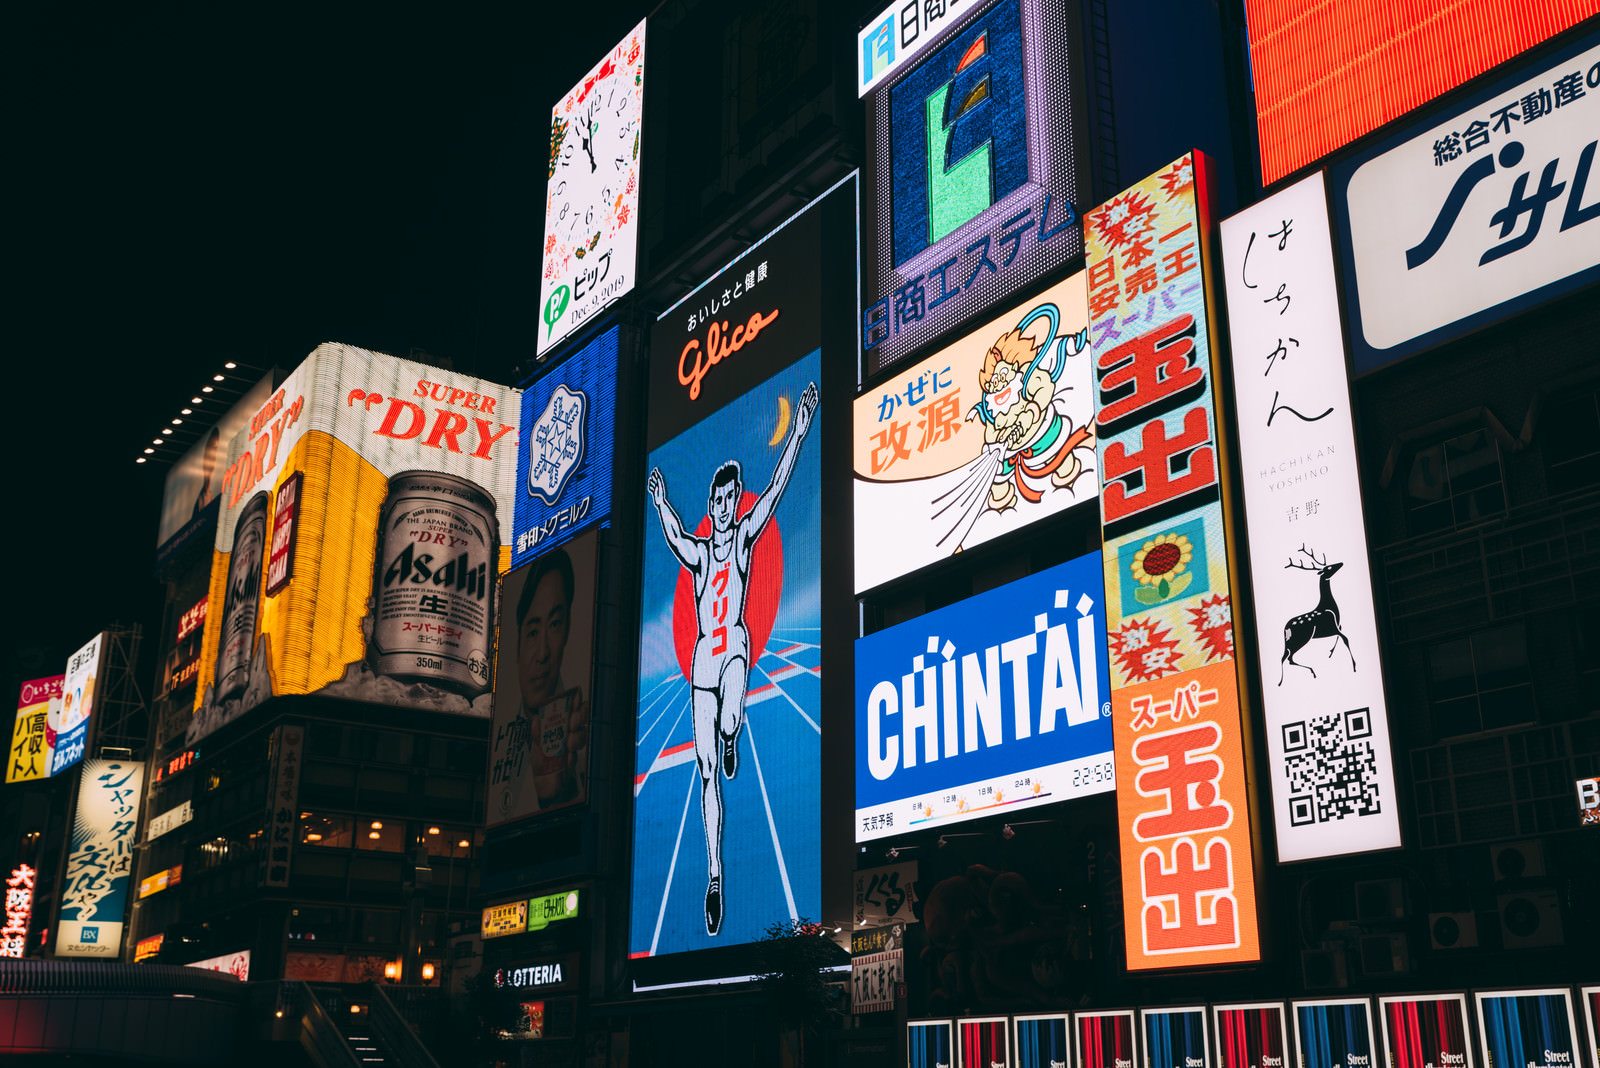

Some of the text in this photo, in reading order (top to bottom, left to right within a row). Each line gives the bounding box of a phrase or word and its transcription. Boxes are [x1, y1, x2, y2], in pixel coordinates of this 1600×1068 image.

[901, 0, 959, 49] 日商
[574, 248, 613, 301] ピップ
[863, 194, 1076, 350] 日商エステム
[1087, 222, 1193, 292] 日本一
[1089, 242, 1198, 321] 安売王
[687, 261, 768, 332] おいしさと健康
[1092, 283, 1201, 349] スーパー
[678, 309, 779, 400] Glico
[248, 388, 285, 441] SUPER
[413, 379, 497, 415] SUPER
[877, 366, 953, 423] かぜに
[1096, 313, 1215, 524] 玉出
[869, 387, 962, 476] 改源
[1260, 445, 1335, 479] HACHIKAN
[1269, 465, 1329, 492] YOSHINO
[422, 518, 447, 527] JAPAN
[449, 519, 473, 536] BRAND
[516, 496, 591, 555] 雪印メグミルク
[384, 542, 486, 600] Asahi
[419, 595, 449, 616] 生
[711, 561, 731, 657] グリコ
[402, 622, 463, 640] スーパードライ
[416, 657, 442, 670] 350ml
[867, 589, 1100, 781] CHINTAI
[1130, 680, 1219, 732] スーパー
[1073, 762, 1113, 787] 22:58
[862, 812, 894, 833] 天気予報
[1132, 719, 1241, 957] 玉出
[82, 929, 97, 940] BX
[507, 963, 562, 988] LOTTERIA
[1115, 1058, 1131, 1068] Street
[1185, 1056, 1203, 1068] Street
[1262, 1054, 1282, 1066] Street
[1347, 1053, 1368, 1065] Street
[1440, 1051, 1463, 1064] Street
[1544, 1049, 1570, 1062] Street
